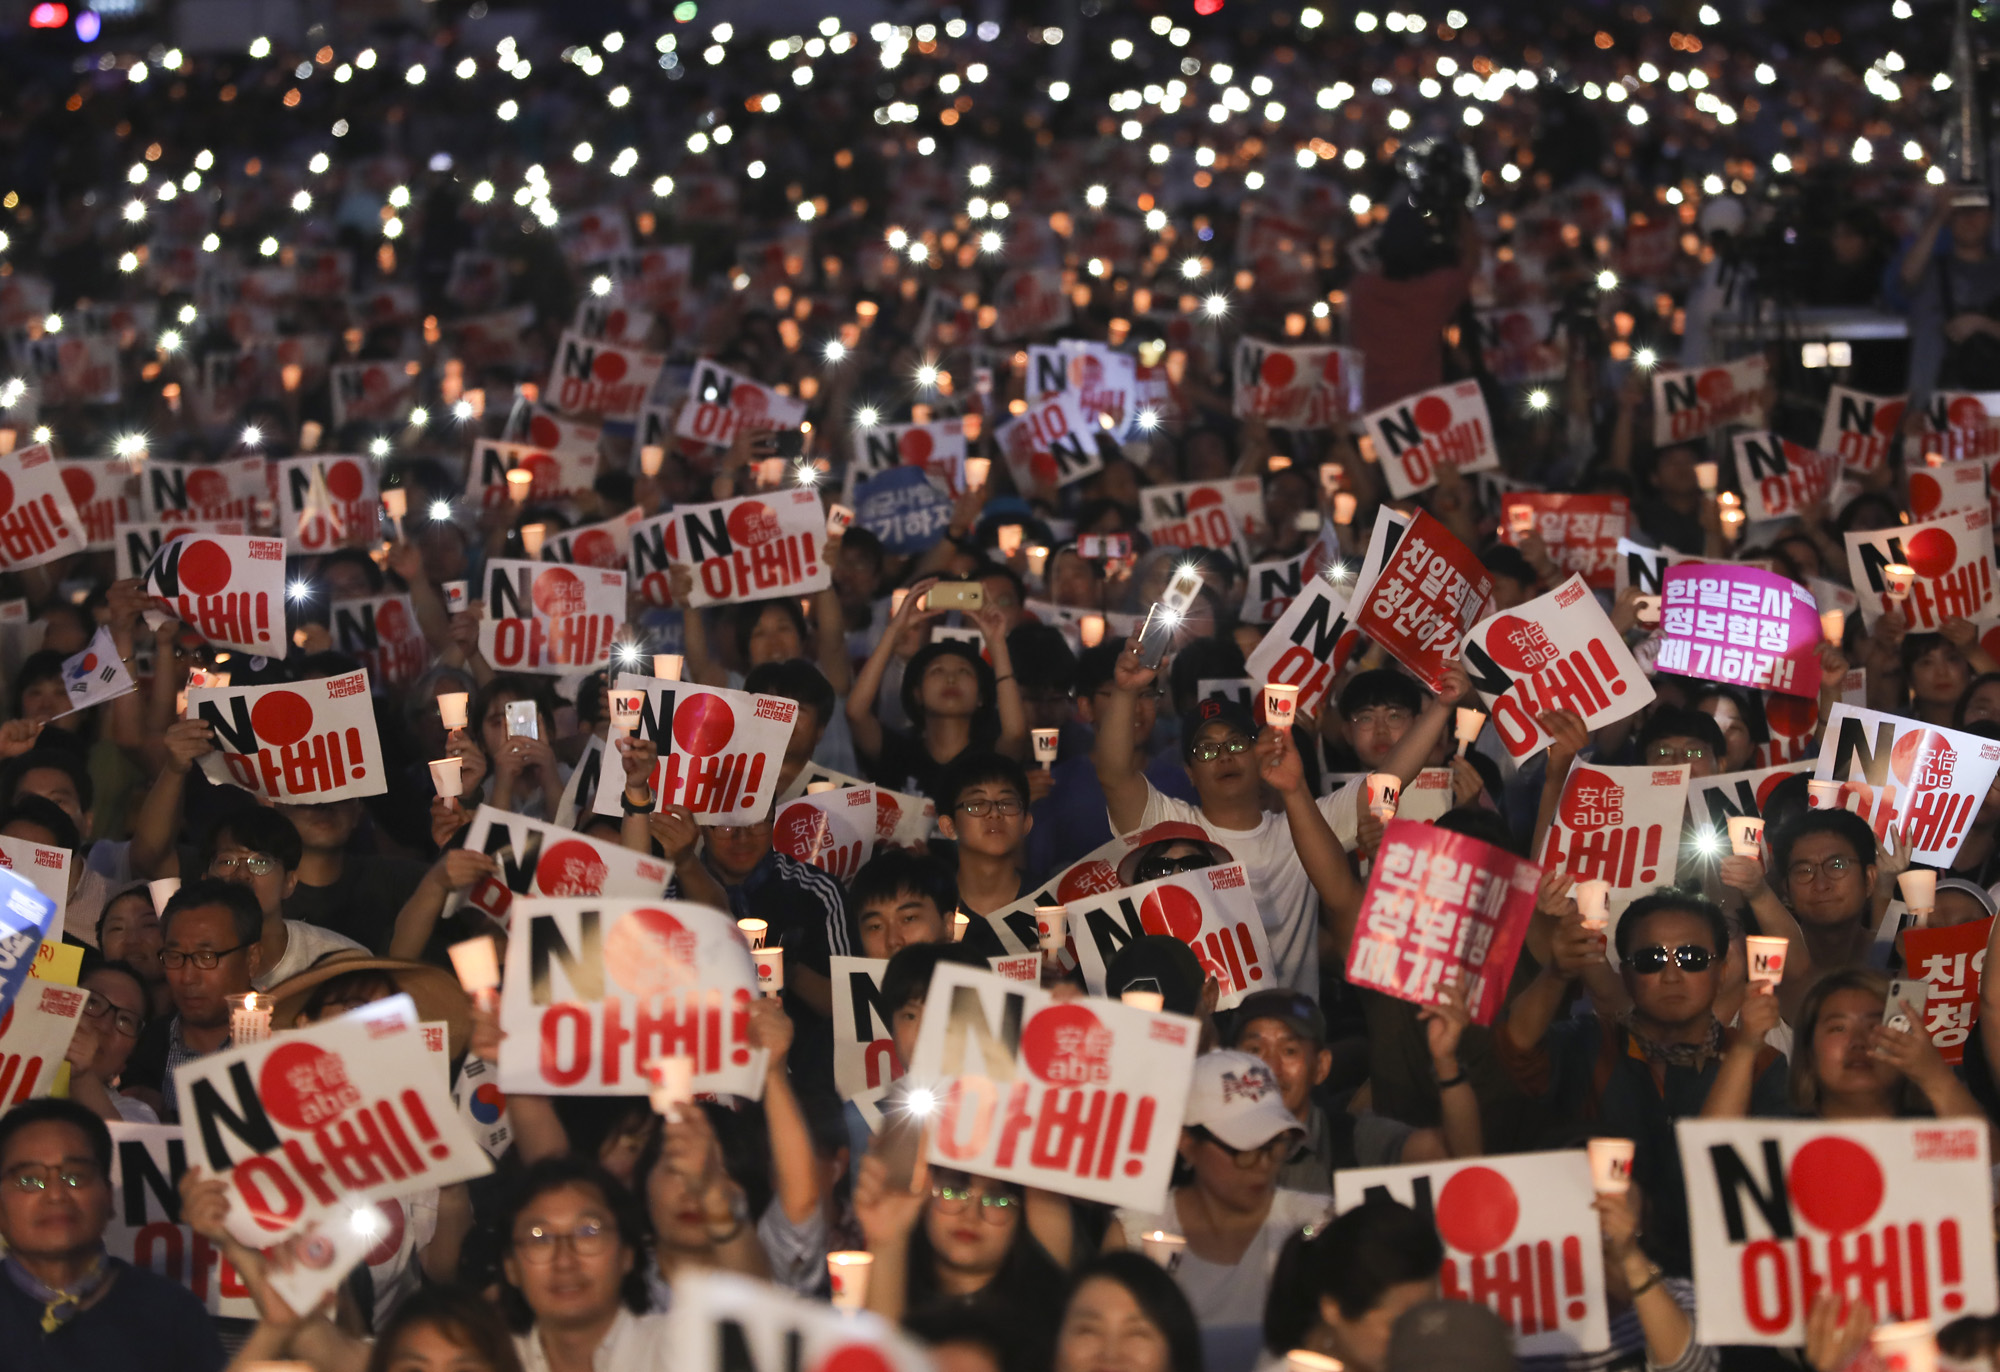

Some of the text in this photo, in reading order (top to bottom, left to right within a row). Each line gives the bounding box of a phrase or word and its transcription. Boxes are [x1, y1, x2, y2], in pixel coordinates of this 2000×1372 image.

[700, 532, 818, 600] 아베!
[1666, 578, 1793, 620] 한일군사
[1508, 621, 1548, 653] 安倍
[1664, 607, 1790, 653] 정보협정
[1522, 643, 1561, 669] abe
[1657, 638, 1796, 690] 폐기하라!
[326, 673, 365, 690] 아베규탄
[753, 708, 794, 724] 시민행동
[756, 697, 797, 716] 아베규탄
[1916, 749, 1957, 773] 安倍
[1911, 772, 1953, 790] abe
[1577, 785, 1624, 810] 安倍
[790, 810, 830, 839] 安倍
[1573, 808, 1624, 827] abe
[794, 831, 834, 857] abe
[1207, 866, 1243, 882] 아베규탄
[997, 957, 1037, 972] 아베규탄
[1048, 1054, 1111, 1085] abe
[936, 1075, 1157, 1181] 아베!
[232, 1089, 451, 1232] 아베!
